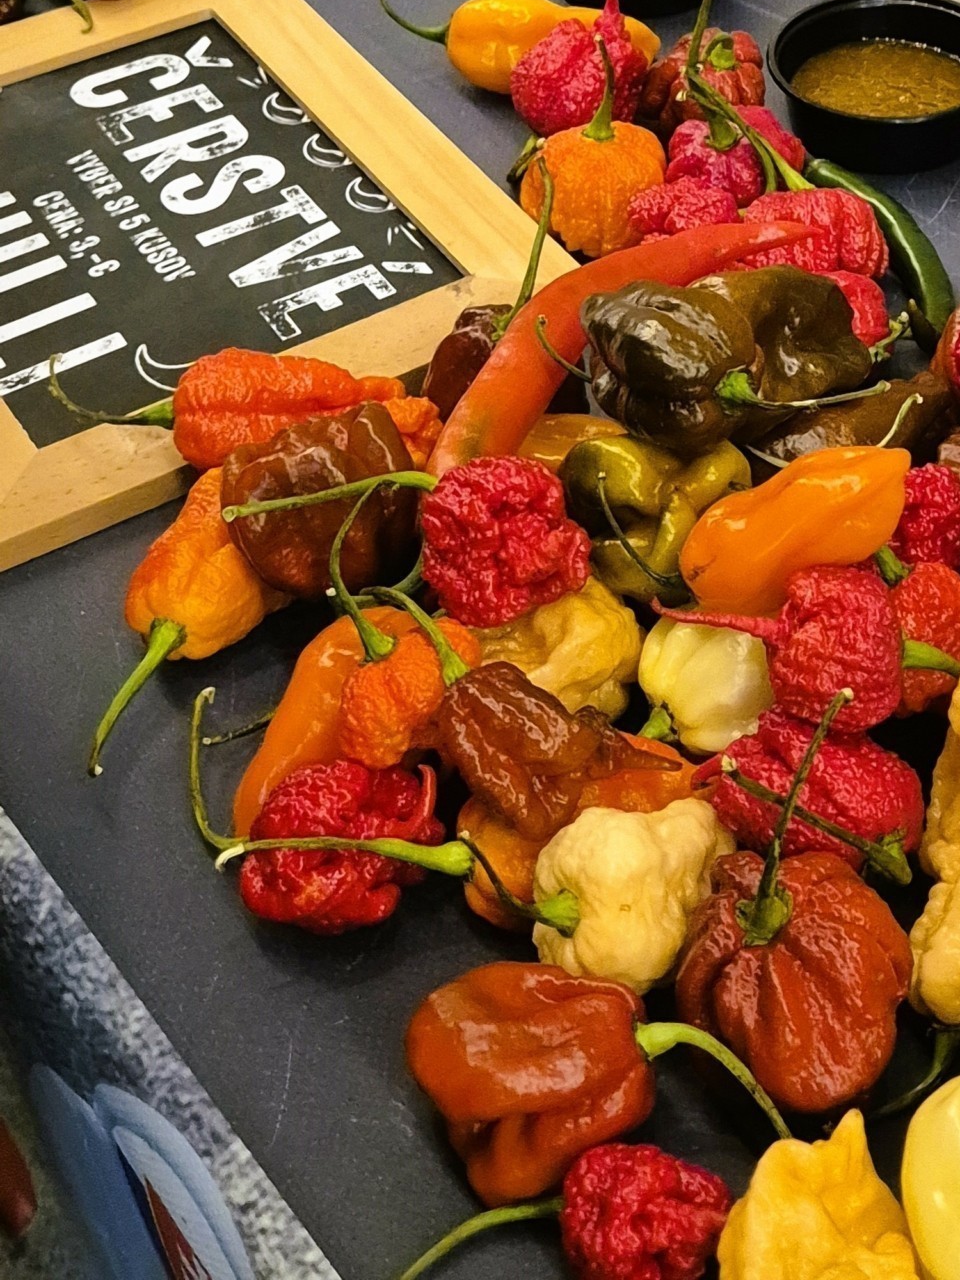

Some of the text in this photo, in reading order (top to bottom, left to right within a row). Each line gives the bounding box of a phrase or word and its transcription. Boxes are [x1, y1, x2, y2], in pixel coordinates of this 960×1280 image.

[32, 190, 86, 240] CENA:
[66, 148, 197, 283] VYBER SI 5 KUSOV
[69, 34, 434, 342] ČERSTVÉ
